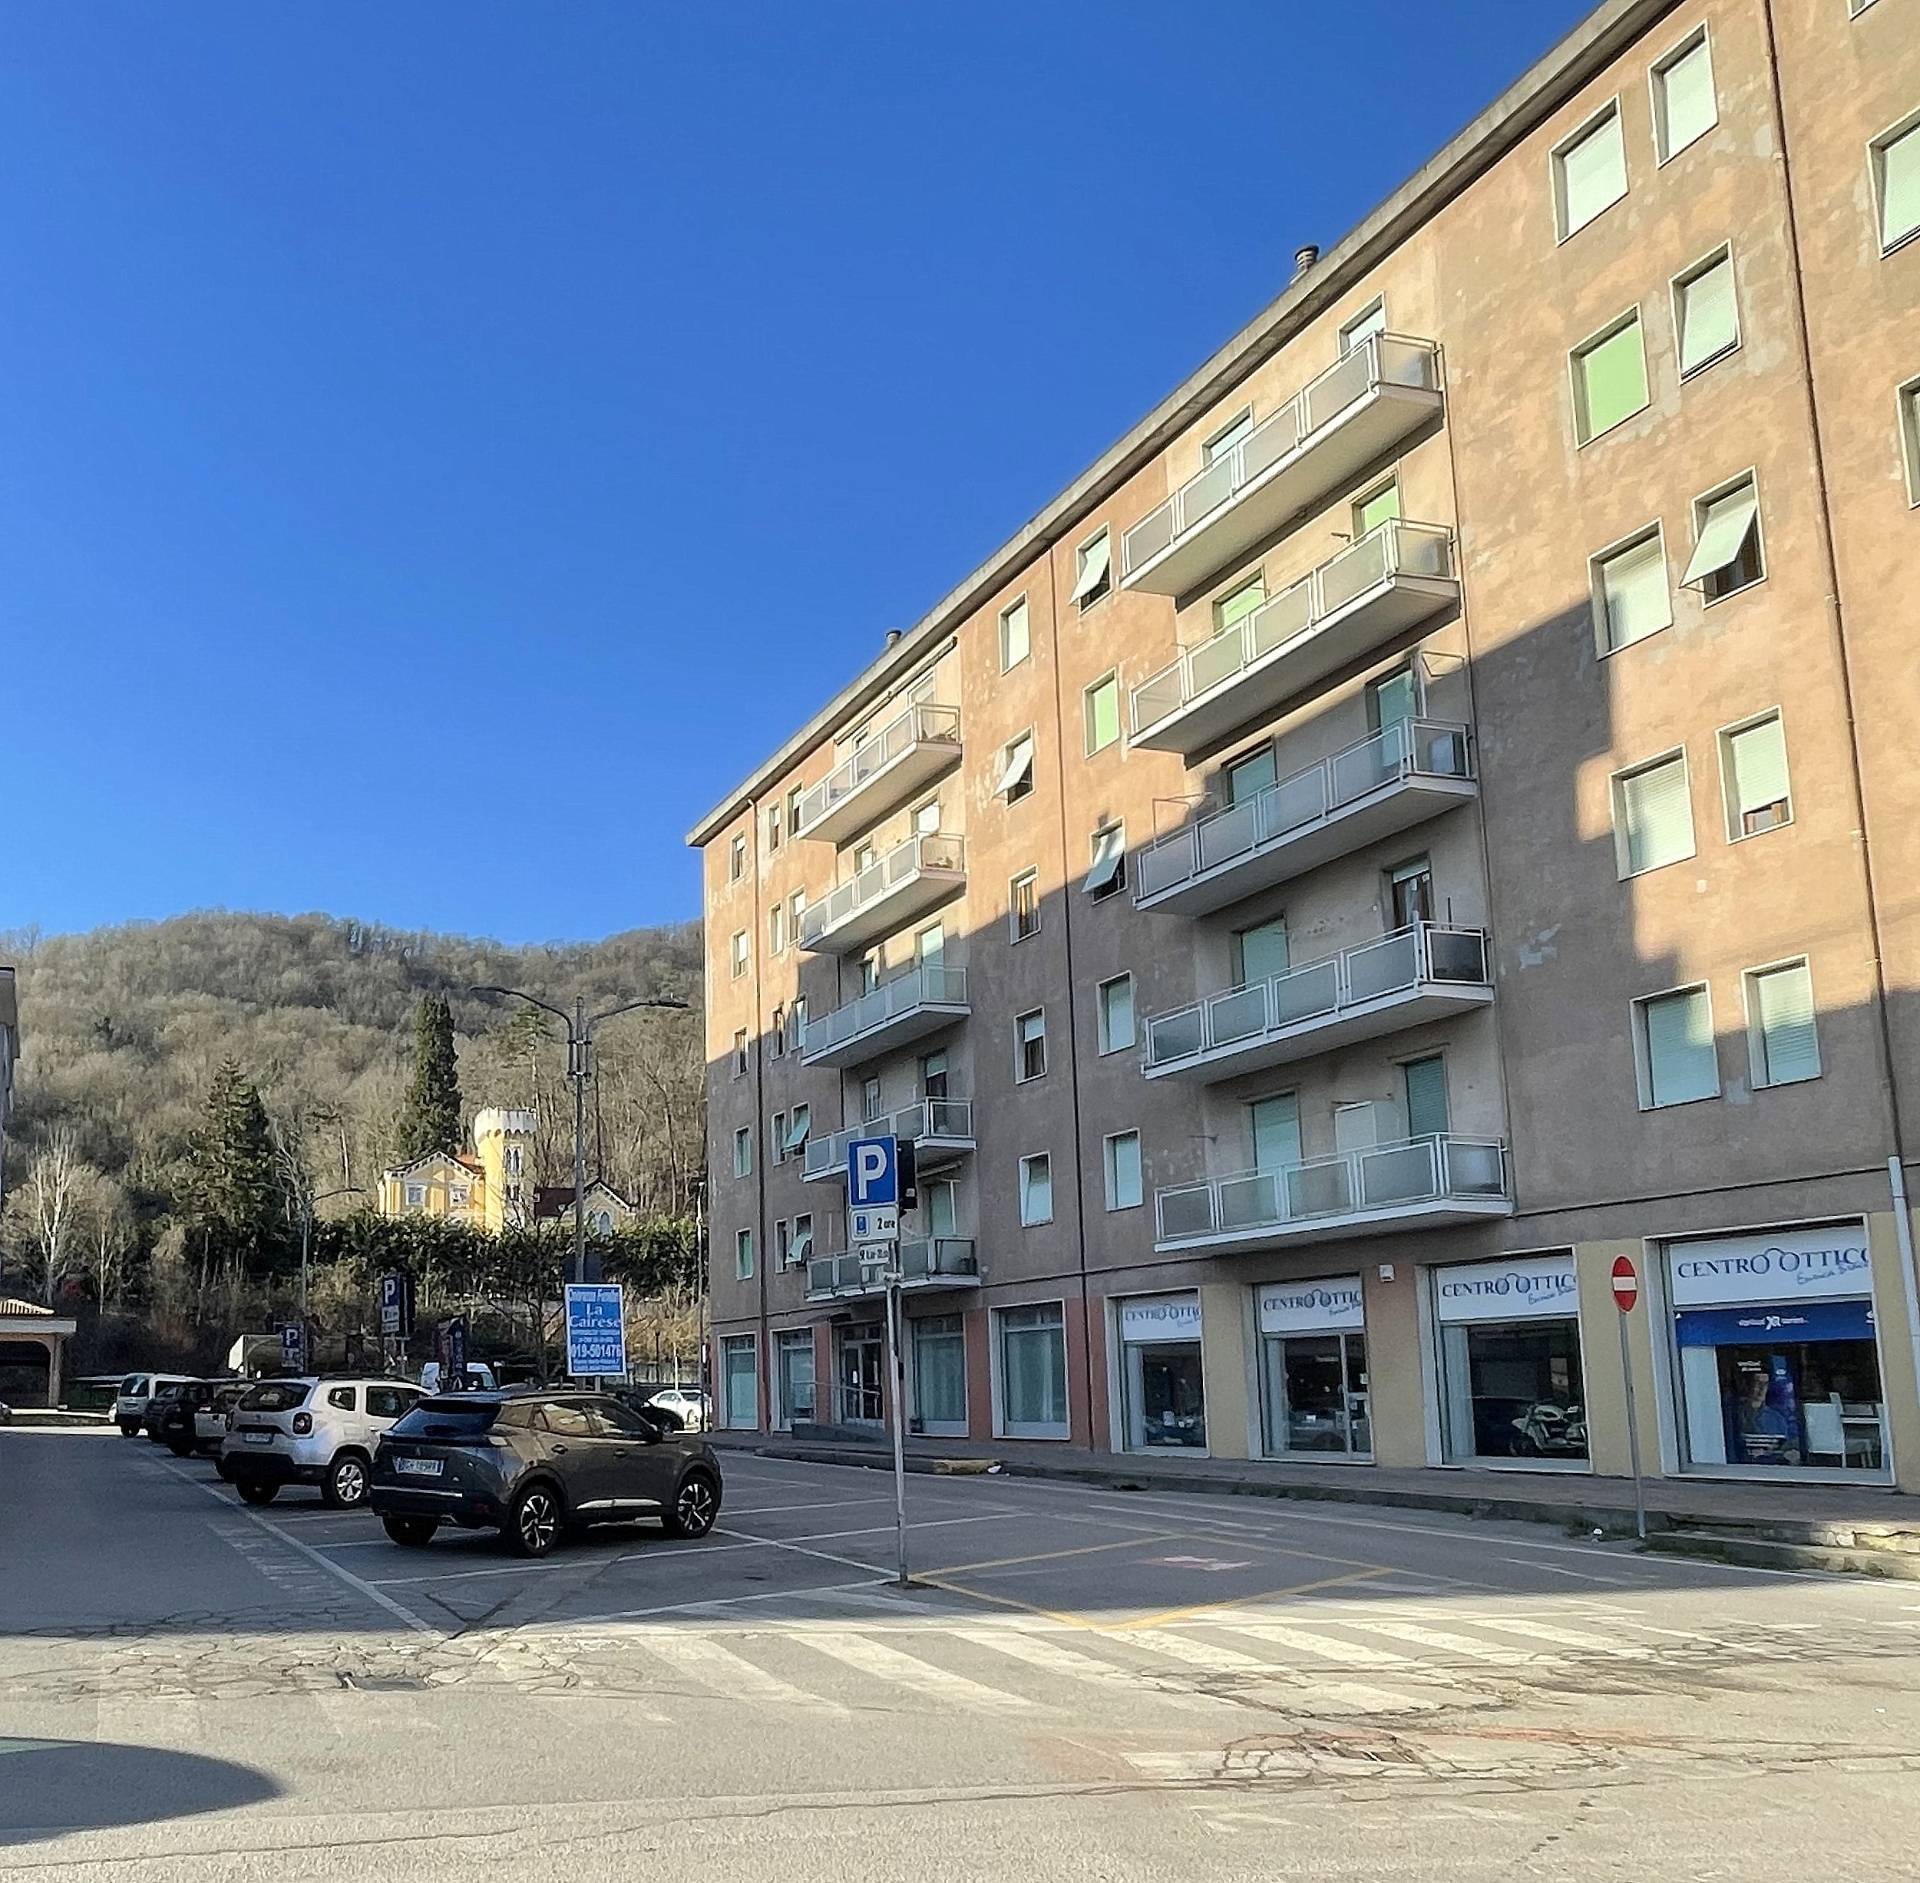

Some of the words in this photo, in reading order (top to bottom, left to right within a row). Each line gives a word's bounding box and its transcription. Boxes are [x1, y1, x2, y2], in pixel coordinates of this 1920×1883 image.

[857, 1144, 887, 1200] P
[877, 1217, 883, 1230] 2
[1678, 1254, 1770, 1279] CENTRO
[384, 1279, 396, 1304] P
[1442, 1277, 1510, 1297] CENTRO
[586, 1303, 603, 1316] La
[1263, 1293, 1315, 1311] CENTRO
[570, 1315, 622, 1328] Cairese
[286, 1328, 298, 1346] P
